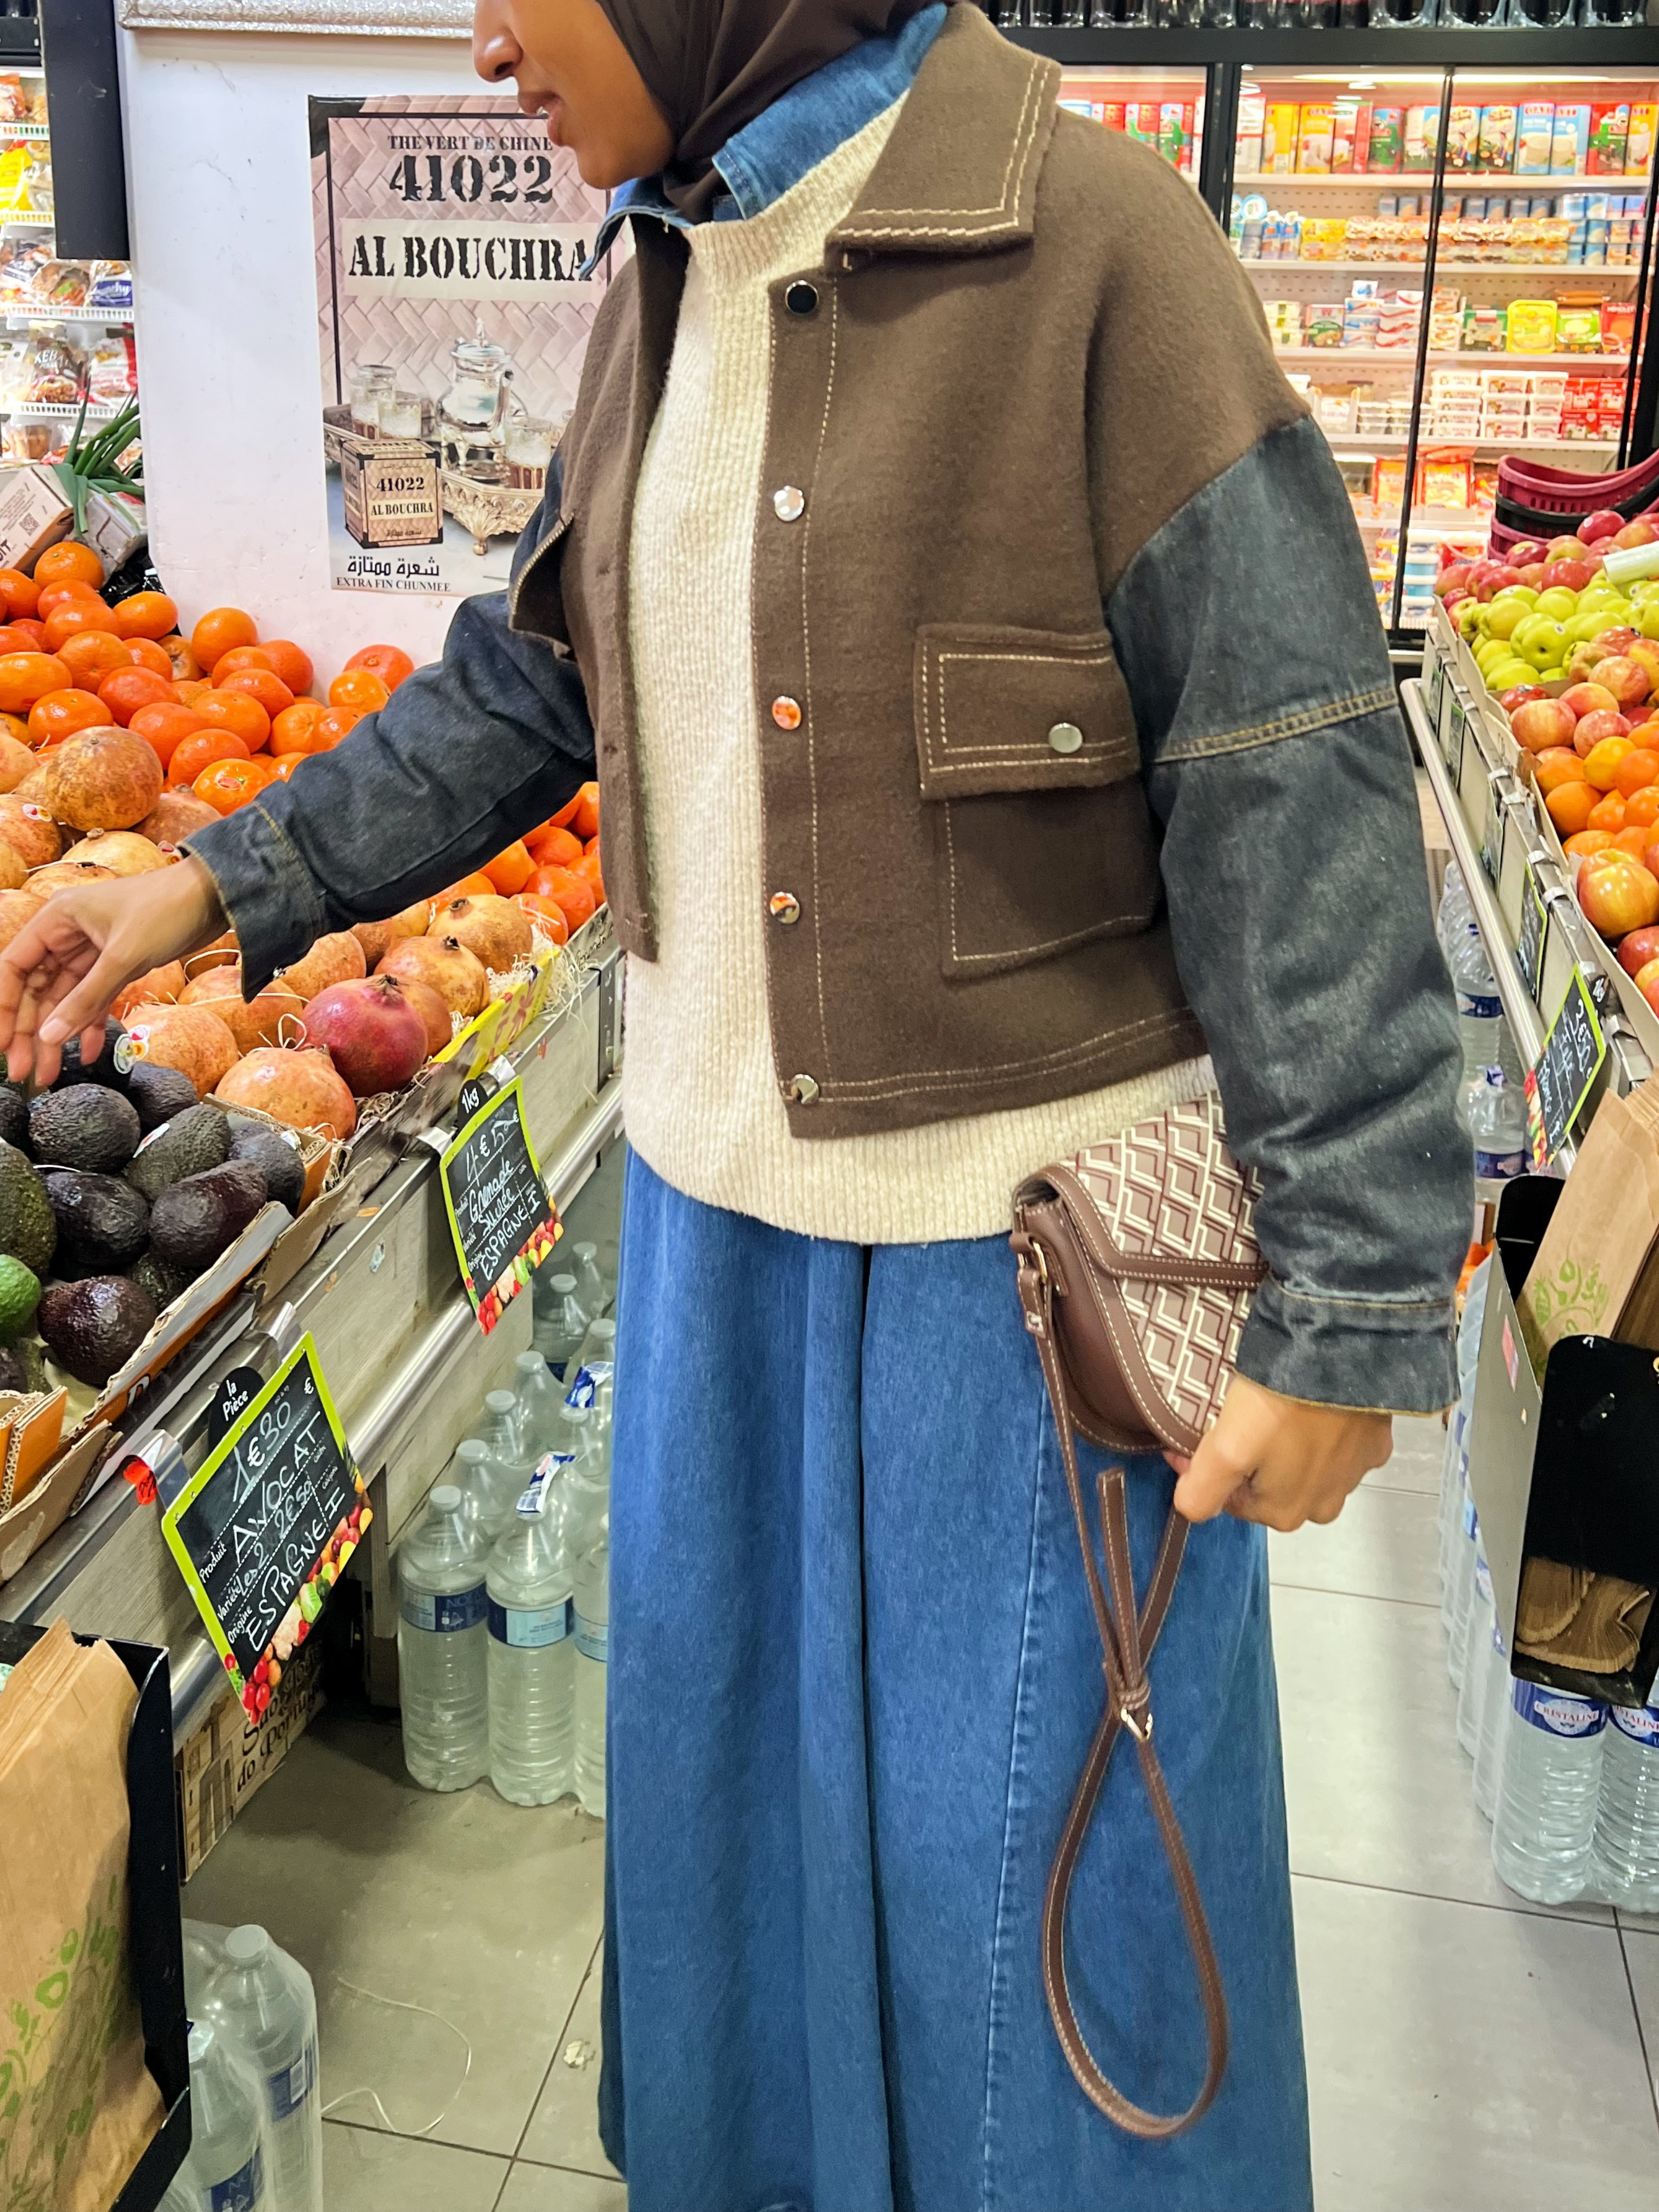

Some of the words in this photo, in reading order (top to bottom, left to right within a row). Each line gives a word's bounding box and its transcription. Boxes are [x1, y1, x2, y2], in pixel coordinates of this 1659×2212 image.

[387, 136, 421, 150] THE
[425, 136, 470, 150] VERT
[473, 136, 495, 150] DE
[500, 136, 553, 151] CHINE
[389, 155, 553, 203] 41022
[349, 235, 395, 277] AL
[403, 236, 592, 281] BOUCHRA
[376, 477, 425, 492] 41022
[371, 504, 384, 516] AL
[386, 502, 433, 515] BOUCHRA
[347, 556, 391, 576] ممتازة
[396, 556, 439, 579] شعرة
[336, 577, 373, 588] EXTRA
[375, 579, 393, 589] FIN
[396, 580, 452, 592] CHUNMEE
[461, 1087, 480, 1114] 1kg
[479, 1205, 529, 1281] ESPAGNE
[226, 1379, 237, 1397] la
[222, 1390, 249, 1421] Pièce
[233, 1410, 321, 1565] AVOCAT
[198, 1539, 228, 1583] Produit
[246, 1519, 327, 1652] ESPAGNE
[217, 1581, 241, 1622] Variété
[227, 1605, 252, 1645] Origine
[1536, 1703, 1598, 1722] CRISTALINE
[1615, 1705, 1659, 1730] ISTALIN
